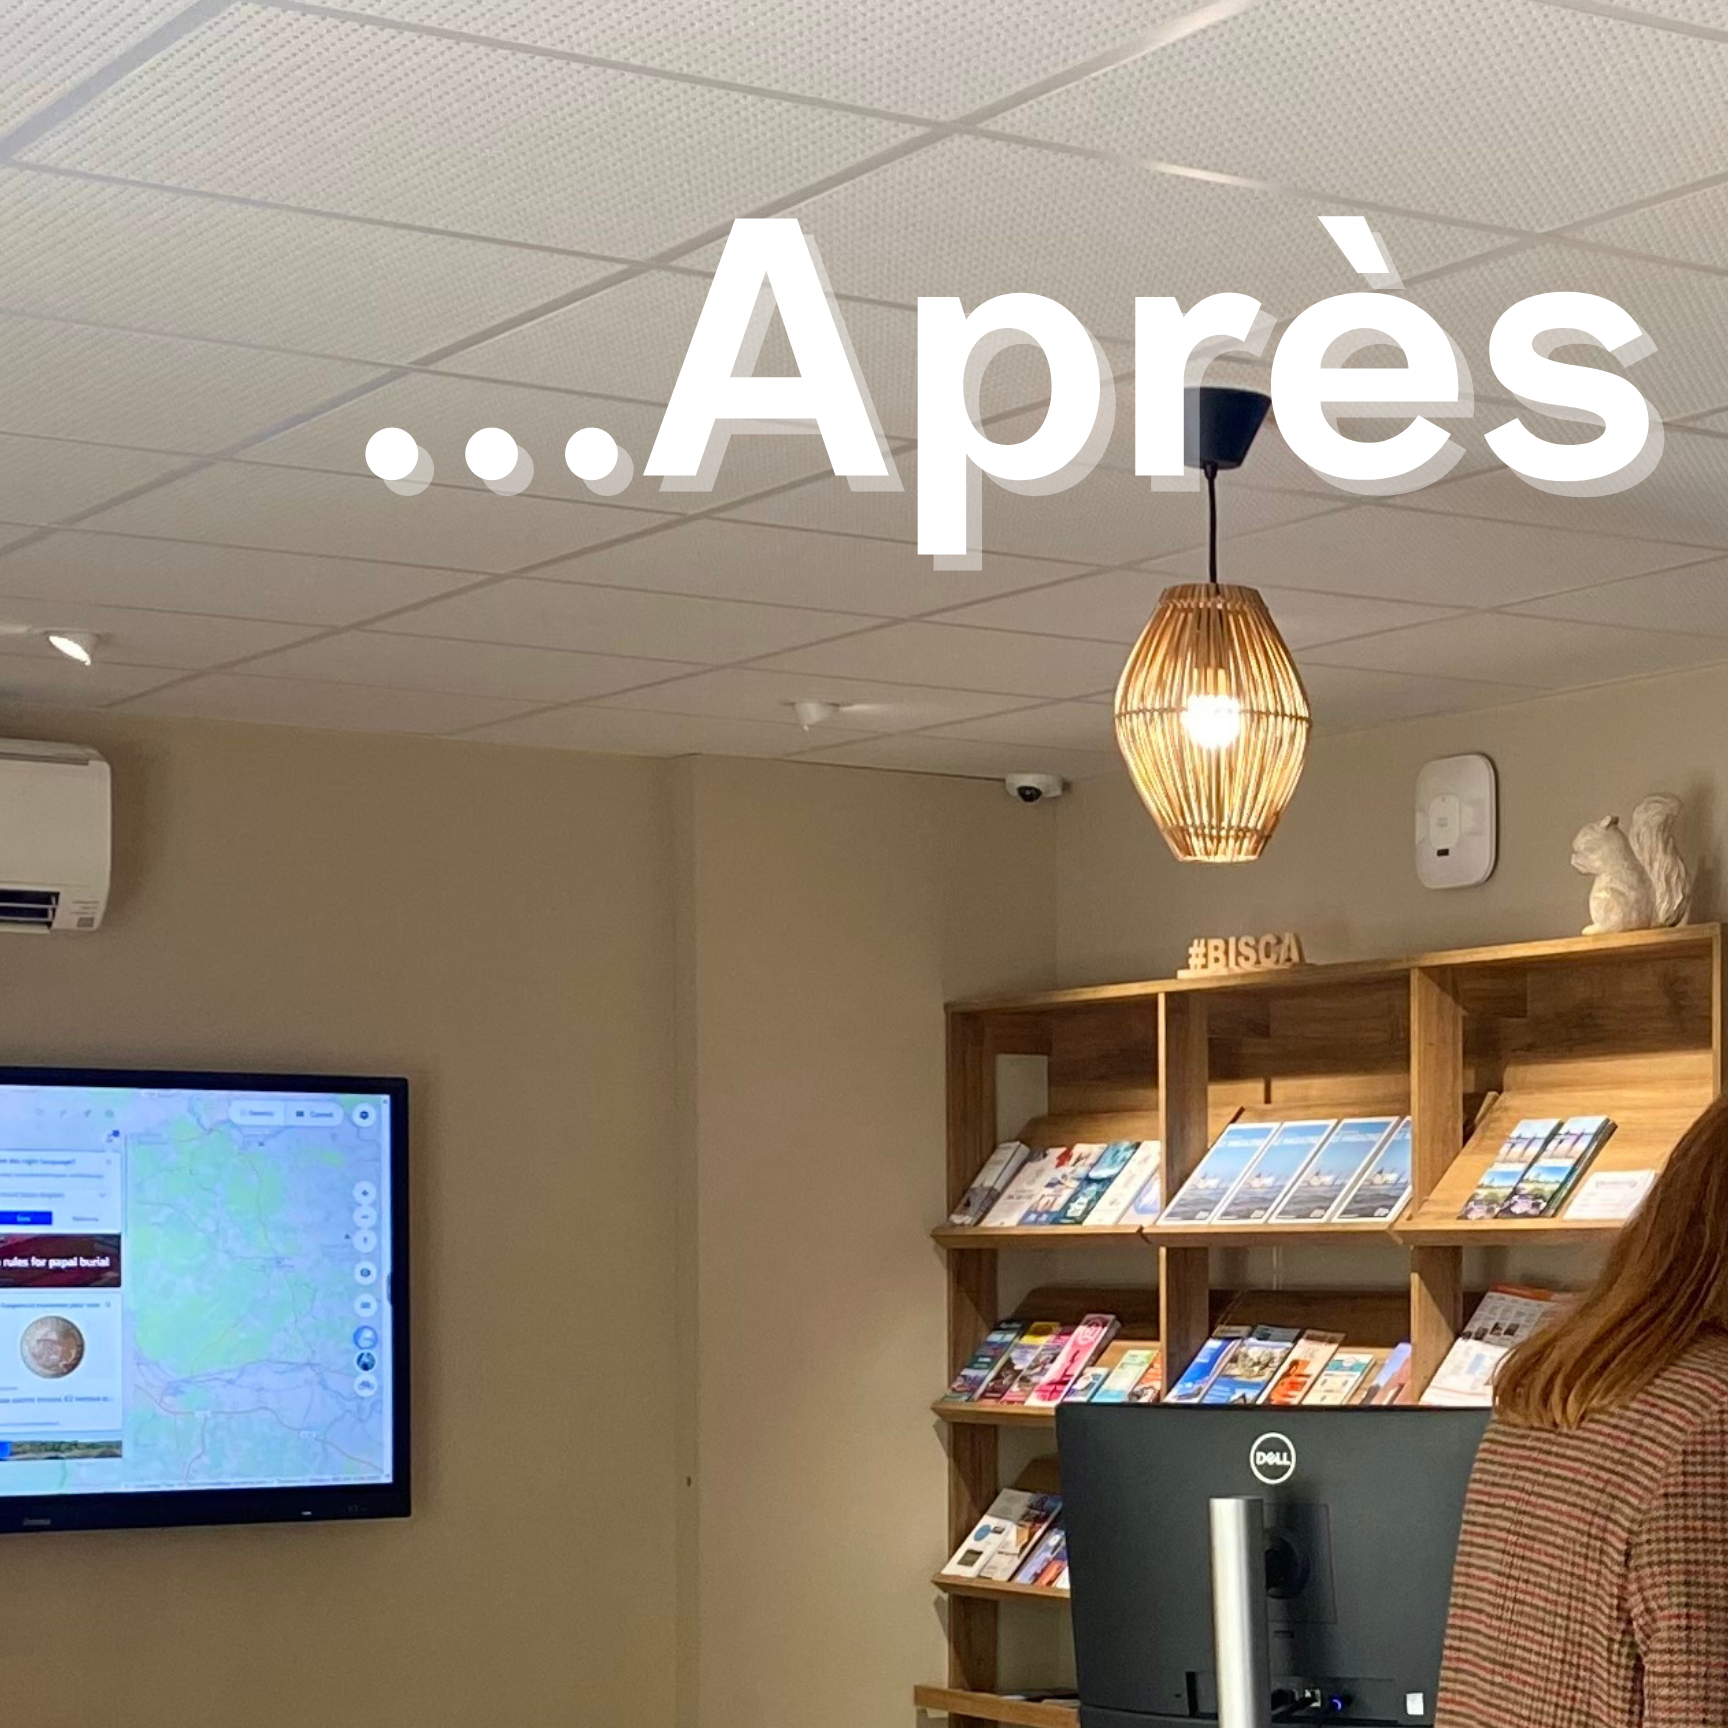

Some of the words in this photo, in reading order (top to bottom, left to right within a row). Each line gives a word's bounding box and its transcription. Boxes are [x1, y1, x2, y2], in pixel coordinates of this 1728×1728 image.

[1188, 931, 1301, 971] #BISCA
[3, 1256, 29, 1268] rules
[31, 1255, 46, 1268] for
[48, 1256, 78, 1270] papal
[79, 1256, 111, 1268] burial
[1255, 1451, 1292, 1466] DELL
